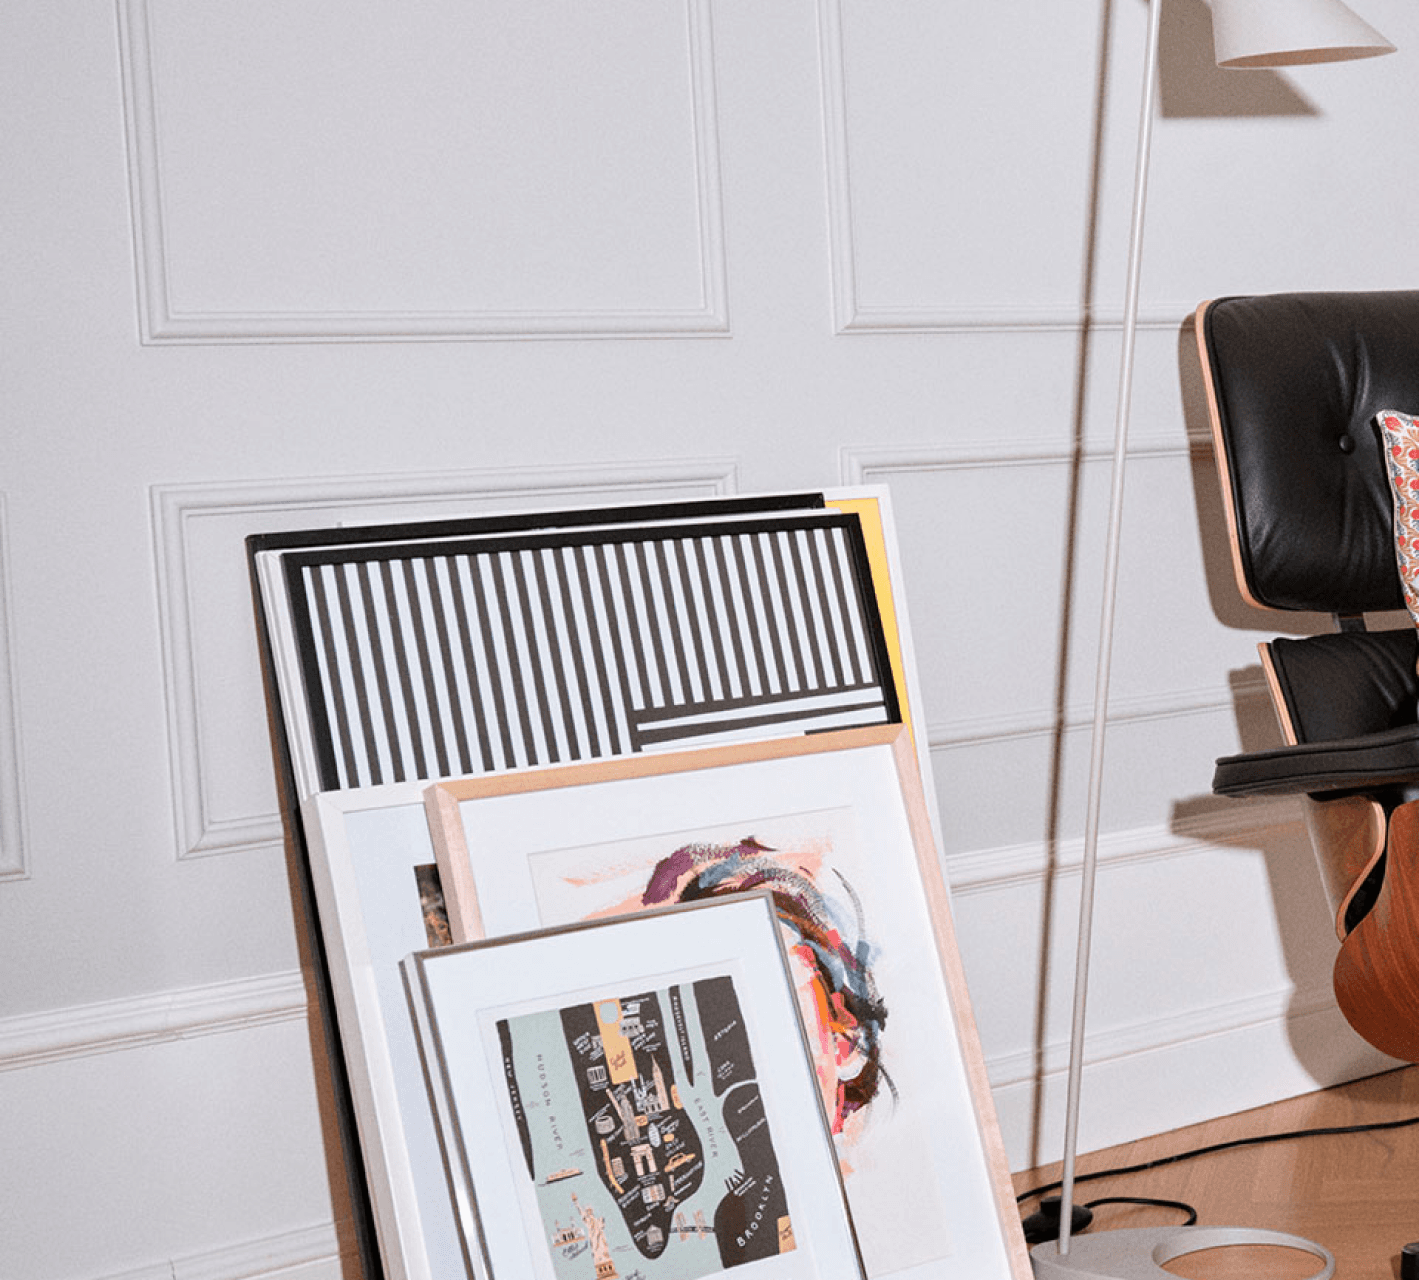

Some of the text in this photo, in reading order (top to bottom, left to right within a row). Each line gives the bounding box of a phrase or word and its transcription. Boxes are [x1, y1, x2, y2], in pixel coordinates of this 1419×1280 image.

[536, 1053, 551, 1107] HUDSON
[706, 1125, 718, 1158] RIVER
[736, 1173, 774, 1247] BROOKLYN
